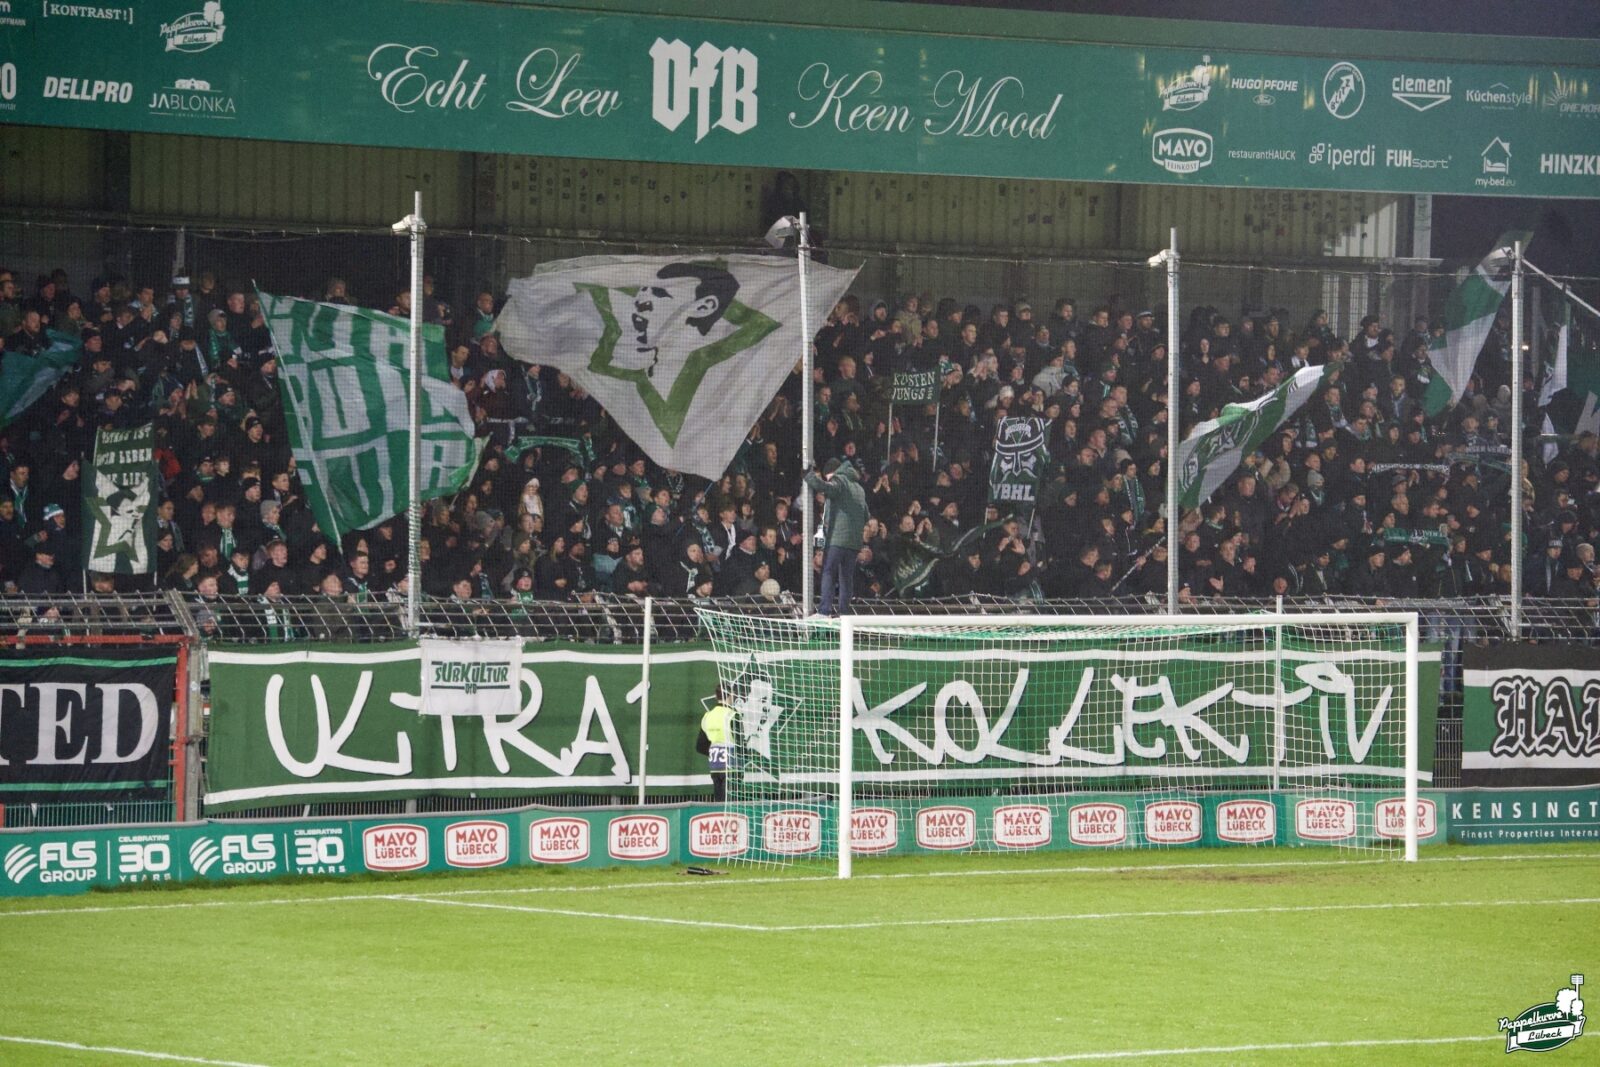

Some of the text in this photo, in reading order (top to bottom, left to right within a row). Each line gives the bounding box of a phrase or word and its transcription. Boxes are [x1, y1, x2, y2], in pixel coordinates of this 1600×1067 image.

[43, 76, 133, 103] DELLPRO
[367, 36, 1063, 144] Echt Leev VfB Keen Mood
[1231, 78, 1299, 92] HUGO PFOHE
[1392, 74, 1453, 93] clement
[148, 92, 236, 112] JABLONKA
[1466, 89, 1533, 107] Küchenstyle
[1158, 138, 1207, 158] MAYO
[1228, 150, 1296, 161] restaurantHAUCK
[1327, 143, 1376, 170] iperdi
[992, 483, 1035, 501] VBHL
[850, 662, 1394, 769] KOLLEKTIV
[1077, 810, 1117, 823] MAYO
[1154, 808, 1193, 821] MAYO
[1226, 806, 1266, 819] MAYO
[1306, 805, 1346, 818] MAYO
[1385, 805, 1426, 817] MAO
[1452, 801, 1598, 819] KENSINGT
[850, 815, 888, 829] MAYO
[926, 812, 966, 826] MAYO
[1003, 811, 1042, 825] MAYO
[1226, 819, 1265, 831] LÜBECK
[1306, 818, 1346, 829] LÜBECK
[1385, 817, 1426, 829] LÜBK
[294, 828, 343, 836] CELEBRATING
[540, 825, 580, 839] MAYO
[618, 822, 660, 837] MAYO
[700, 820, 738, 834] MAYO
[926, 826, 966, 838] LÜBECK
[1003, 824, 1042, 837] LÜBECK
[1078, 822, 1117, 834] LÜBECK
[1154, 820, 1193, 832] LÜBECK
[118, 834, 170, 842] CELEBRATING
[374, 832, 417, 847] MAYO
[456, 828, 498, 843] MAYO
[700, 833, 738, 846] LÜBECK
[850, 828, 887, 840] LÜBECK
[1461, 829, 1598, 841] Finest Properties Interna
[222, 834, 276, 861] FLS
[540, 839, 580, 851] LÜBECK
[618, 836, 660, 848] LÜBECK
[39, 841, 97, 870] FLS
[294, 837, 345, 866] 30
[375, 846, 418, 860] LÜBECK
[456, 843, 498, 856] LÜBECK
[118, 843, 171, 873] 30
[222, 860, 276, 874] GROUP
[296, 866, 346, 875] YEARS
[39, 868, 97, 883] GROUP
[119, 873, 172, 883] YEARS
